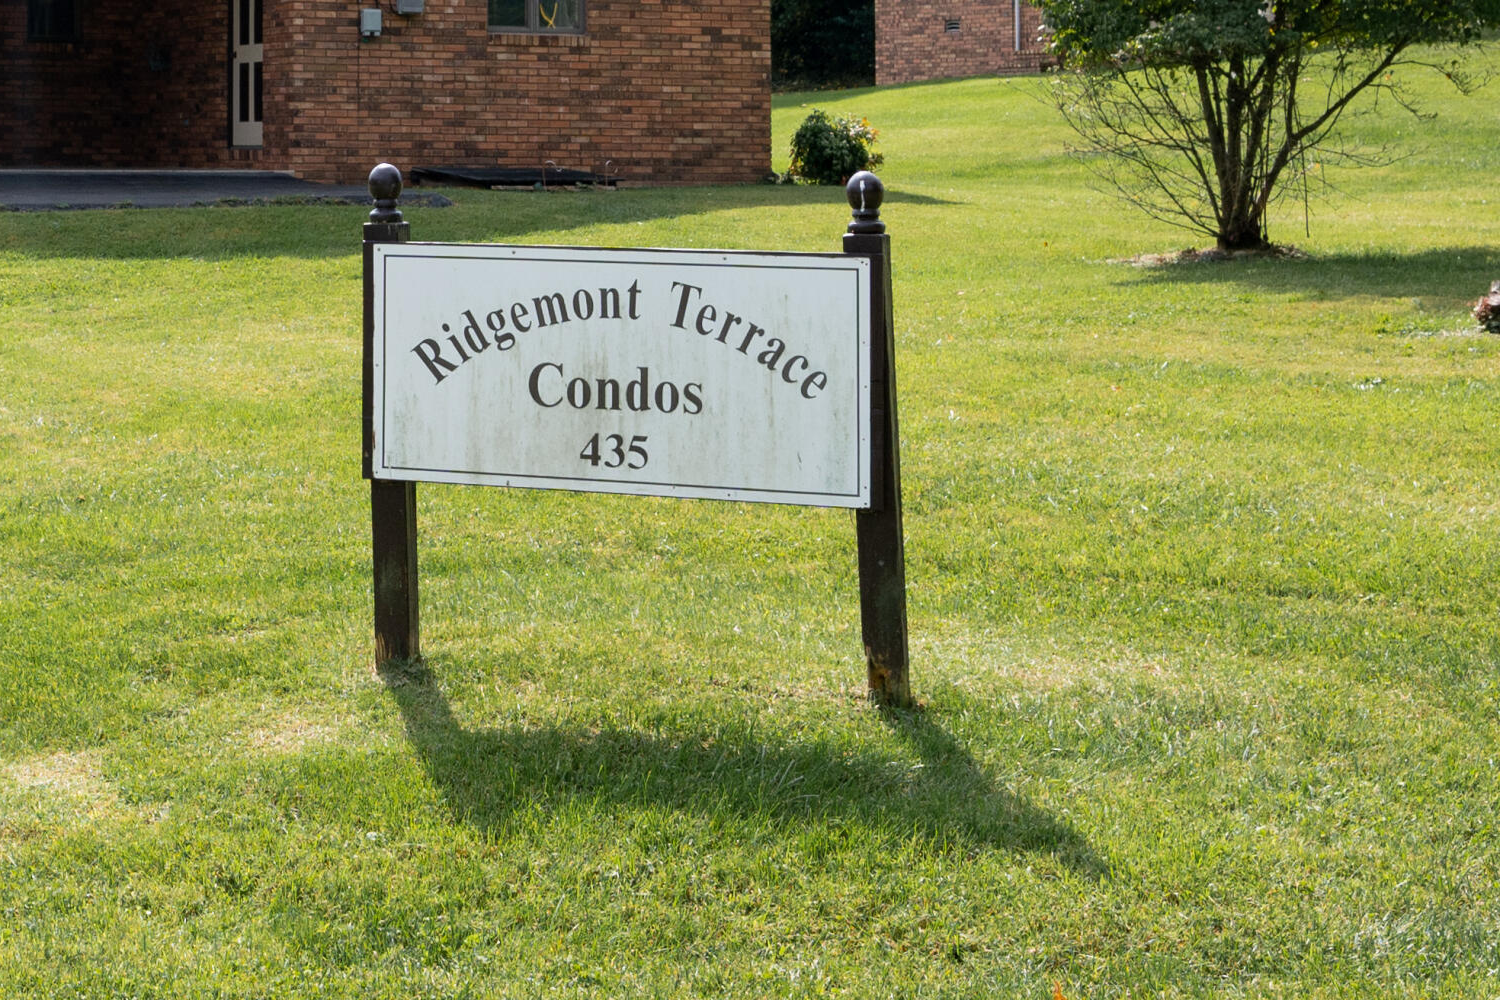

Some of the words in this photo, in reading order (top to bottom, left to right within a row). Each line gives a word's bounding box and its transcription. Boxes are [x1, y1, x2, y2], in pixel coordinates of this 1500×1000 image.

[410, 278, 643, 386] Ridgemont
[669, 281, 829, 400] Terrace
[527, 362, 704, 416] Condos
[579, 432, 650, 470] 435
